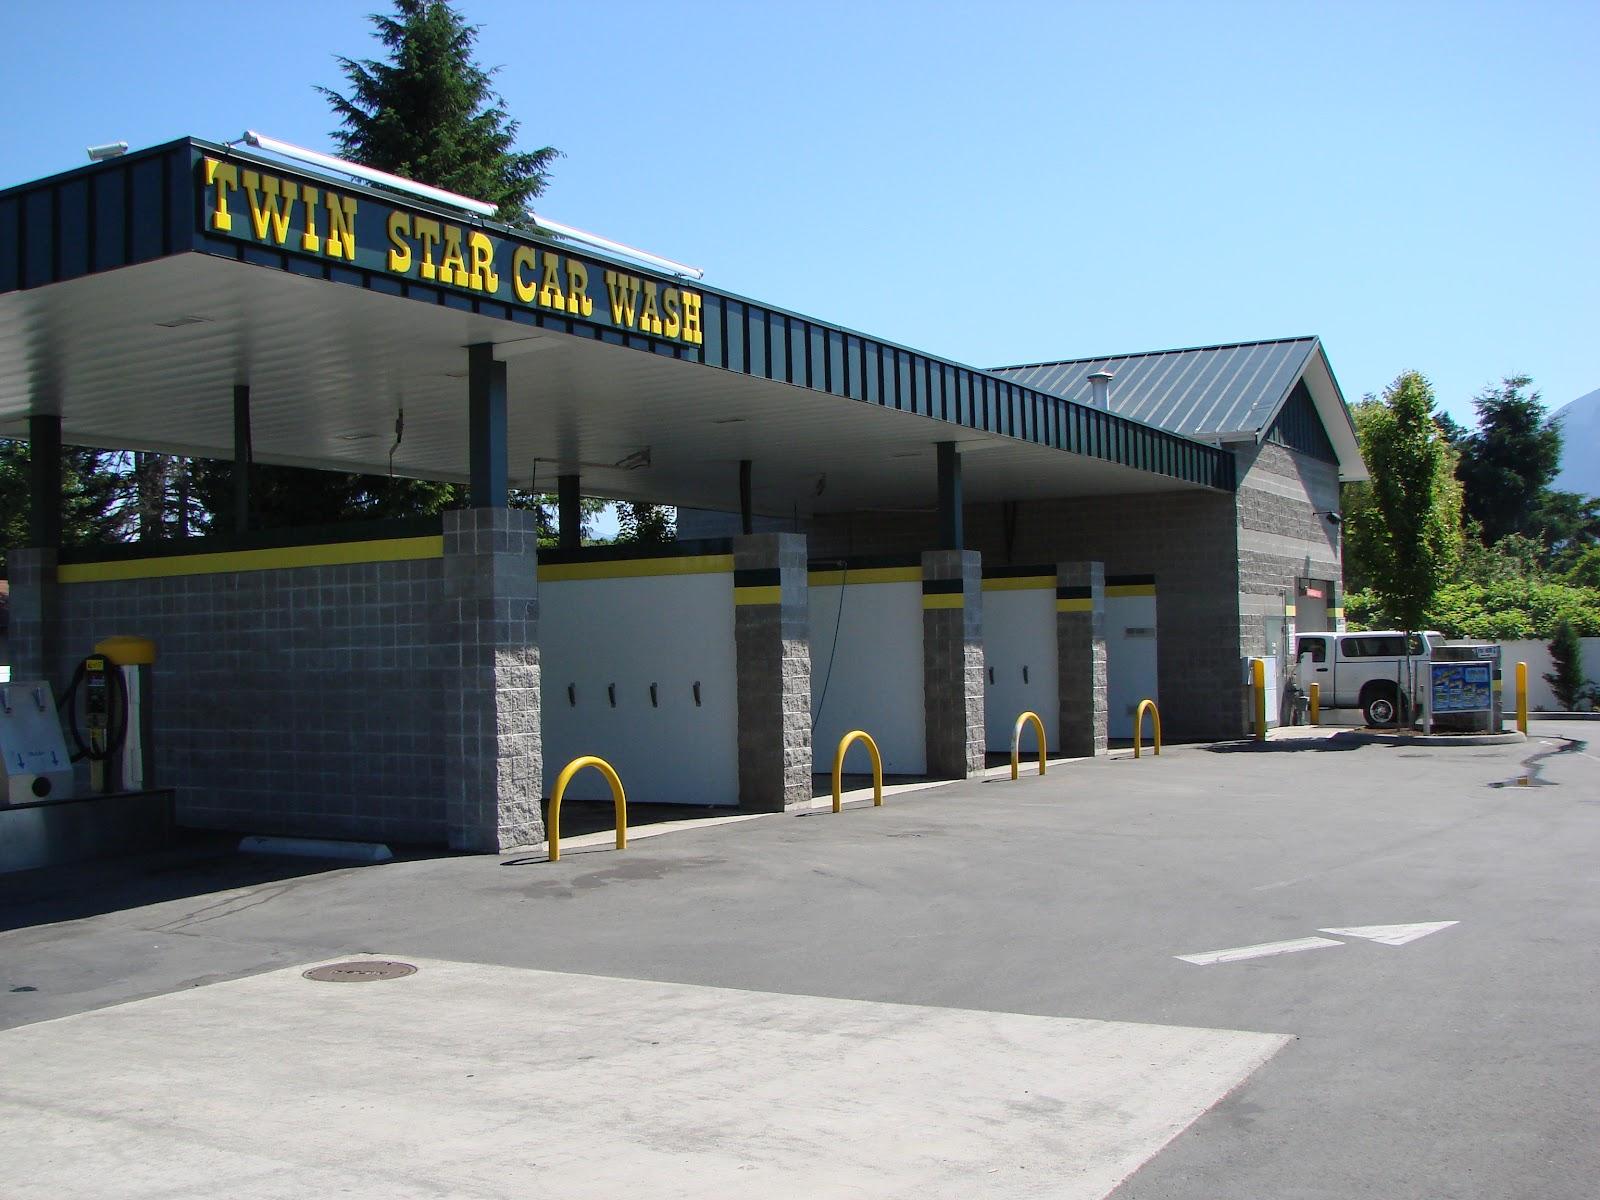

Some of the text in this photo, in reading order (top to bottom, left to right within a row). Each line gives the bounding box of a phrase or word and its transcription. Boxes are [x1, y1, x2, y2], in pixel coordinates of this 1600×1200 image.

[204, 157, 703, 344] TWIN STAR CAR WASH
